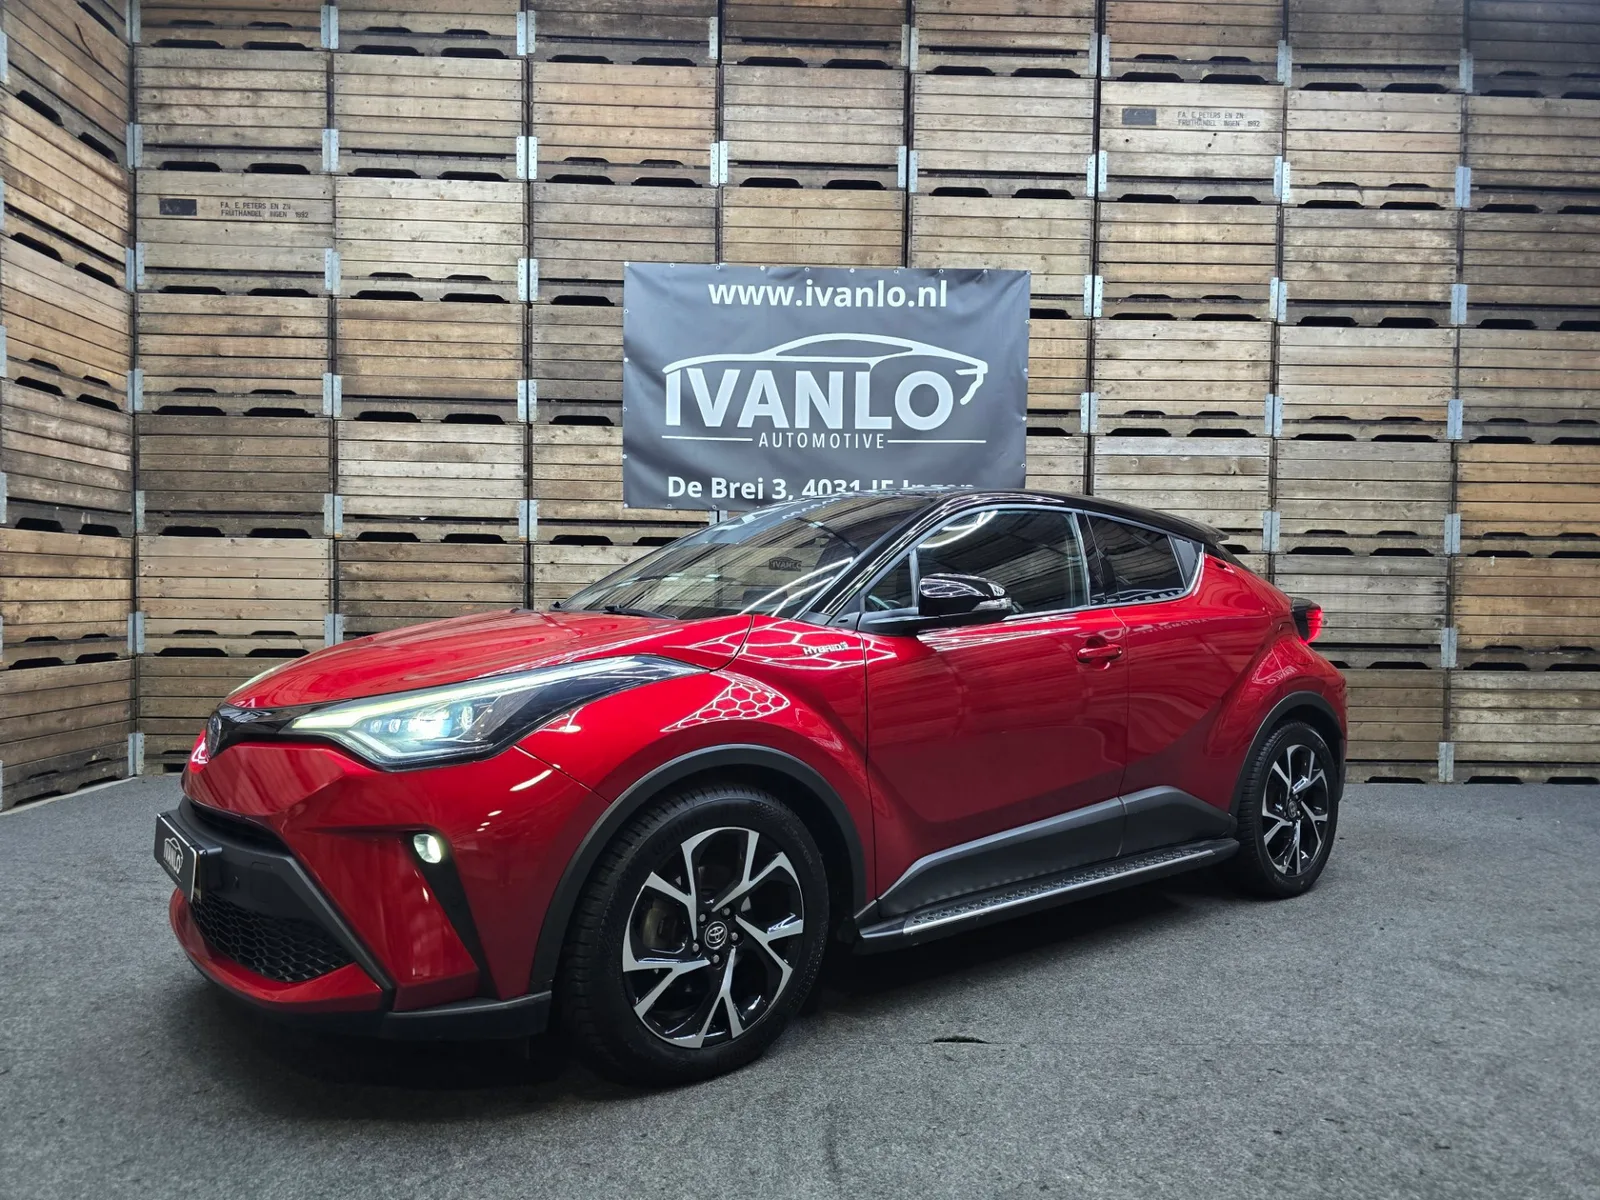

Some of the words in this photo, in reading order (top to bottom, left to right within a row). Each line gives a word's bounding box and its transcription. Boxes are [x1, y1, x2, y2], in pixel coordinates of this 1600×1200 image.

[220, 209, 262, 217] FRUITHANDEL
[708, 279, 948, 308] www.ivanlo.nl
[665, 367, 955, 431] IVANLO
[758, 432, 885, 449] AUTOMOTIVE
[667, 476, 703, 498] De
[711, 477, 764, 500] Brei
[771, 478, 794, 501] 3,
[801, 479, 860, 497] 4031
